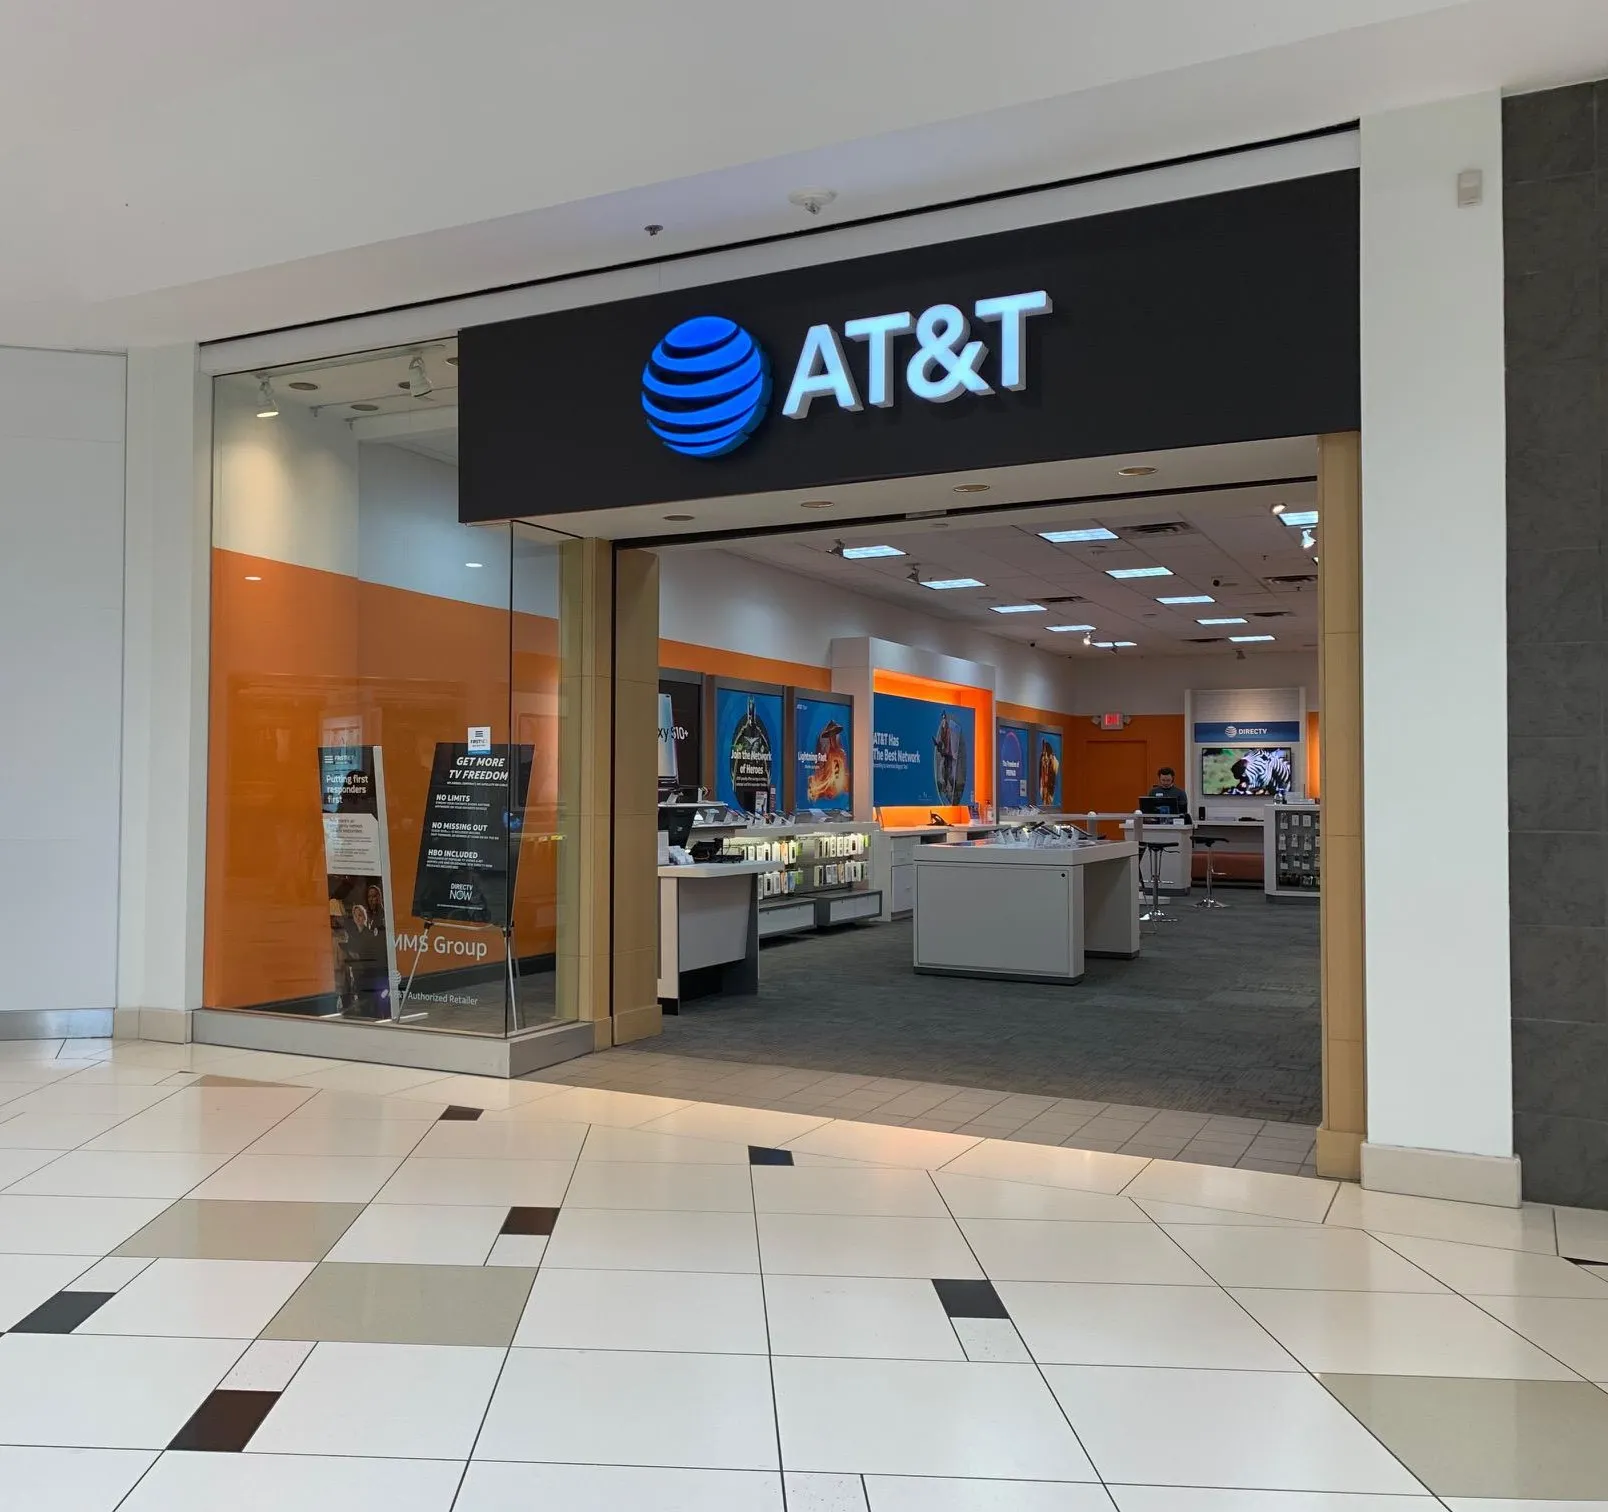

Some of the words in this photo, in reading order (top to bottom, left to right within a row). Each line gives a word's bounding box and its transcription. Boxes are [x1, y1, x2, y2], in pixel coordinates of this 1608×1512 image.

[782, 290, 1053, 419] AT&T
[872, 732, 888, 746] AT&T
[888, 733, 899, 747] Has
[741, 749, 750, 760] the
[750, 749, 772, 761] Network
[797, 751, 818, 764] Lightning
[872, 747, 884, 761] The
[884, 748, 897, 762] Best
[897, 749, 921, 764] Network
[456, 756, 476, 766] GET
[476, 757, 506, 767] MORE
[448, 769, 462, 779] TV
[462, 770, 509, 781] FREEDOM
[739, 763, 746, 774] of
[746, 763, 764, 775] Heroes
[326, 774, 352, 785] Putting
[353, 774, 369, 784] first
[326, 784, 367, 796] responders
[327, 794, 344, 804] first
[436, 793, 447, 801] NO
[447, 794, 471, 803] LIMITS
[431, 821, 442, 830] NO
[442, 822, 472, 831] MISSING
[472, 824, 489, 832] OUT
[427, 848, 443, 857] HBO
[443, 849, 479, 859] INCLUDED
[450, 882, 474, 891] DIRECTV
[449, 890, 473, 901] NOW
[433, 936, 488, 961] Group
[407, 991, 448, 1003] Authorized
[449, 994, 478, 1006] Retailer
